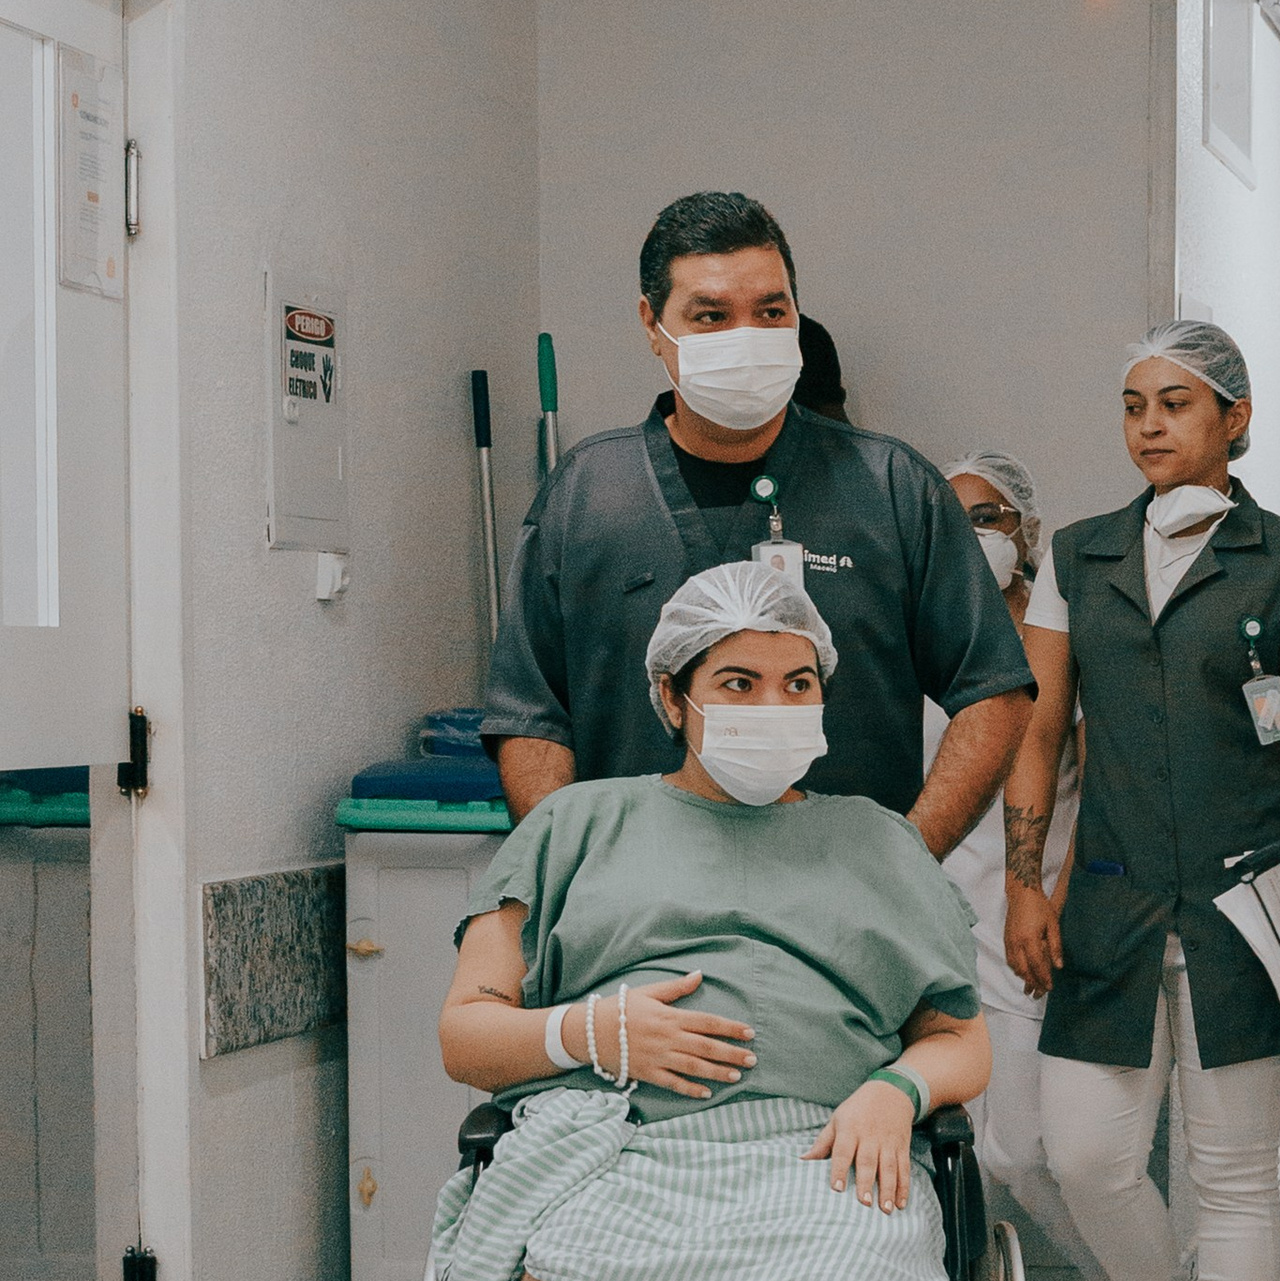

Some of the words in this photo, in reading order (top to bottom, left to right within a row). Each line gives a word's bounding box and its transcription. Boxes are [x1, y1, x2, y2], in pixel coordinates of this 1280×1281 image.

[294, 314, 326, 337] PERIGO
[290, 349, 316, 373] CHOQUE
[803, 549, 837, 566] imed
